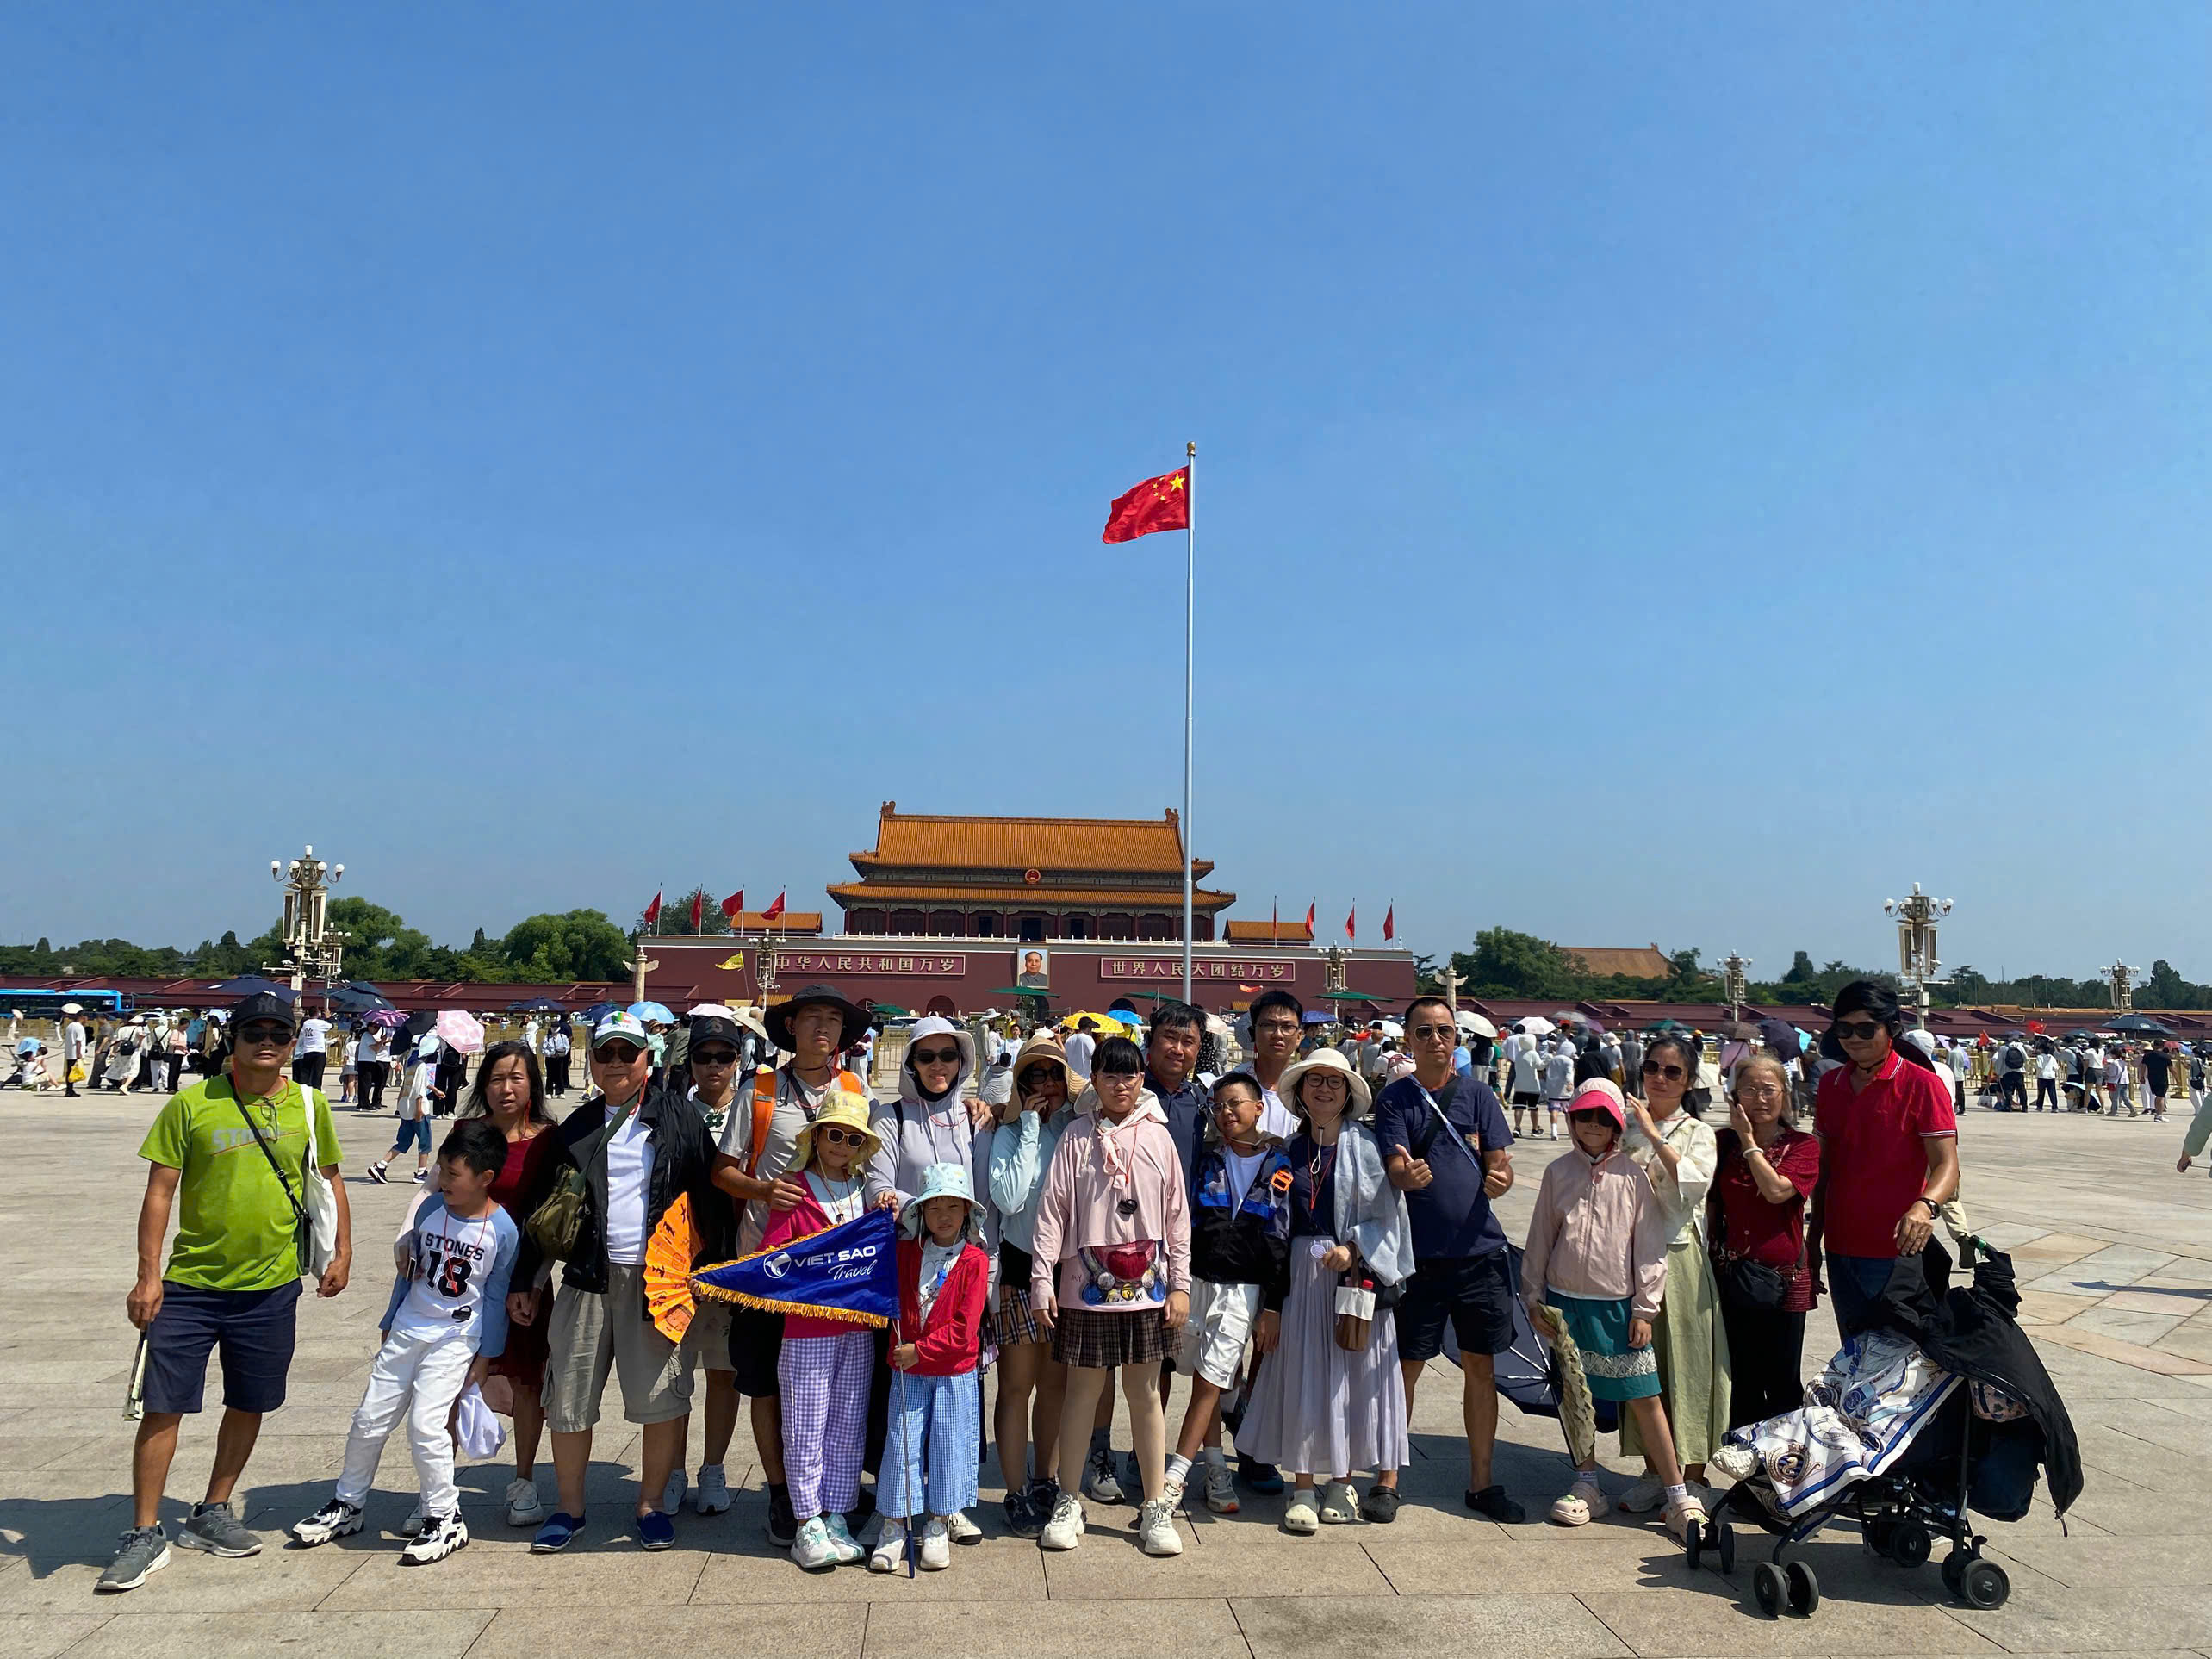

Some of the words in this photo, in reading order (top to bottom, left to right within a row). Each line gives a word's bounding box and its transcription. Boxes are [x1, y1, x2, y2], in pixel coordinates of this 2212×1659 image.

[776, 955, 955, 972] 中华人民共和国万岁
[1111, 961, 1285, 979] 世界人民大团结万岁
[425, 1233, 485, 1261] STONES
[794, 1252, 835, 1268] VIET
[838, 1246, 877, 1261] SAO
[426, 1248, 475, 1299] 18
[828, 1259, 878, 1281] Travel
